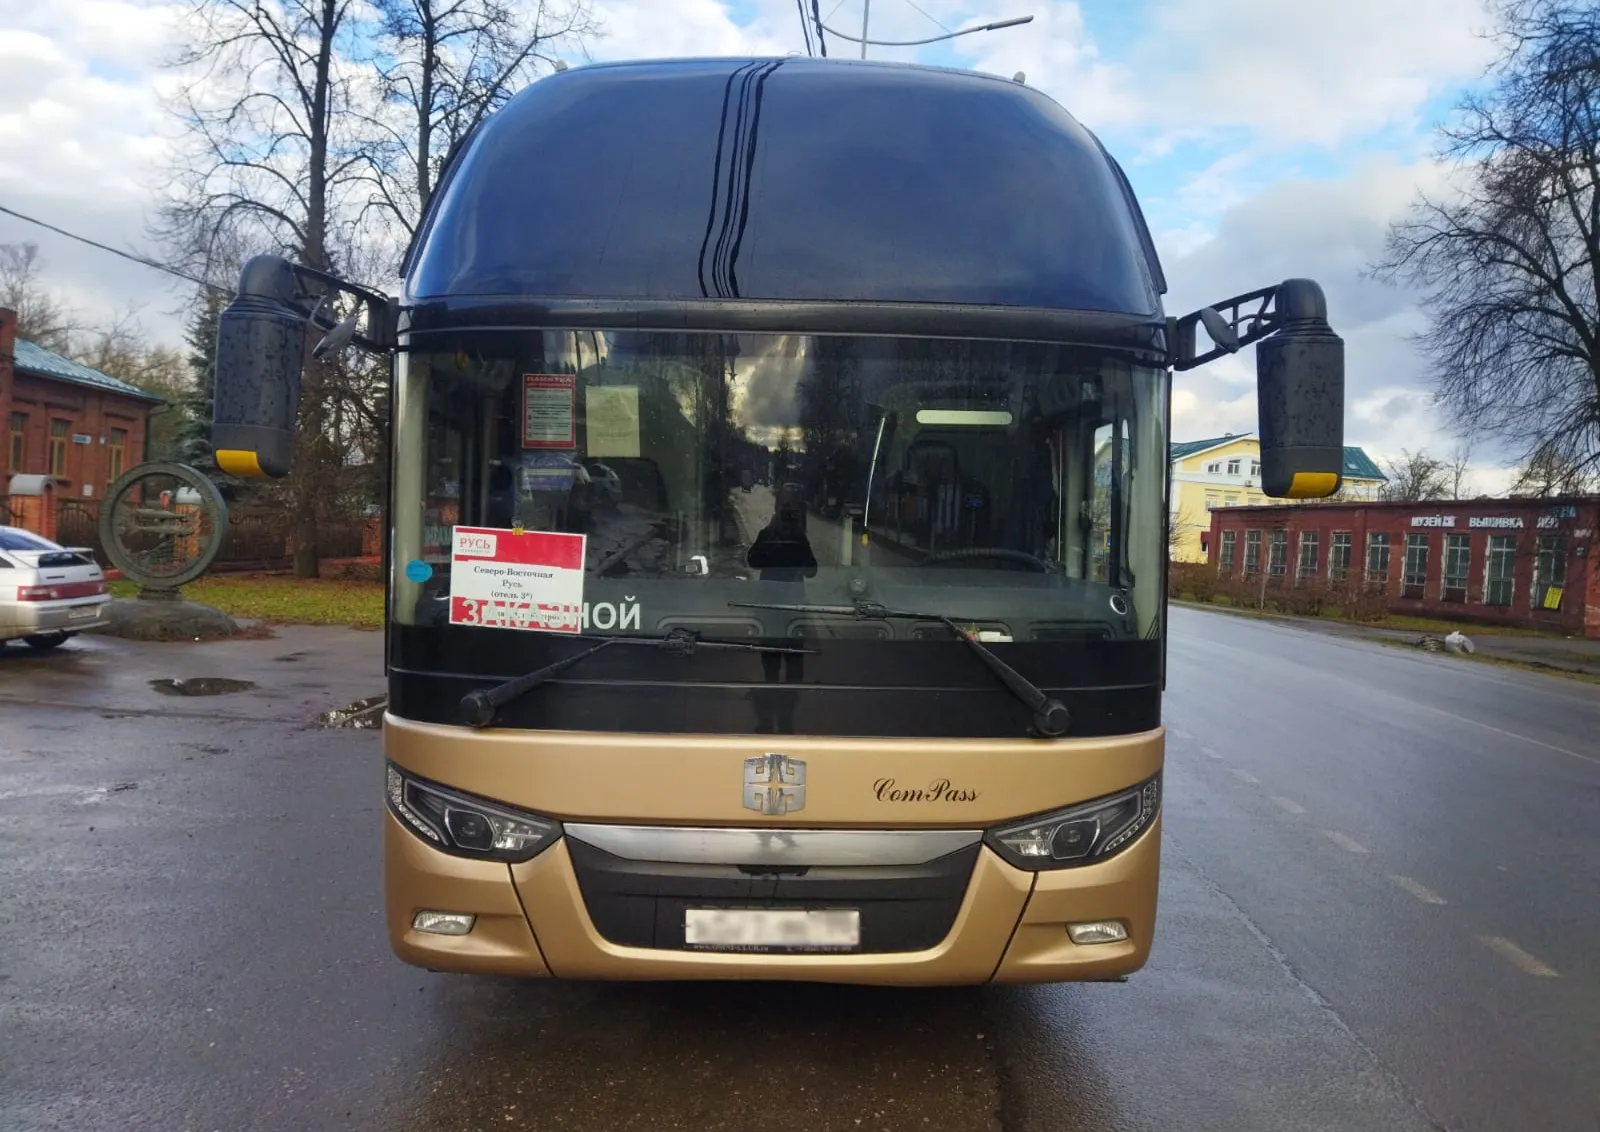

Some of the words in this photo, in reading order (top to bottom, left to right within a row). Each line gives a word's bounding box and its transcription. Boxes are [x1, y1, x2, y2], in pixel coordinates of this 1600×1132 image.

[474, 565, 554, 579] Северо-Восточная
[502, 579, 523, 589] Русь
[462, 595, 640, 629] ЗАКАЗНОЙ
[873, 777, 982, 802] ComPass
